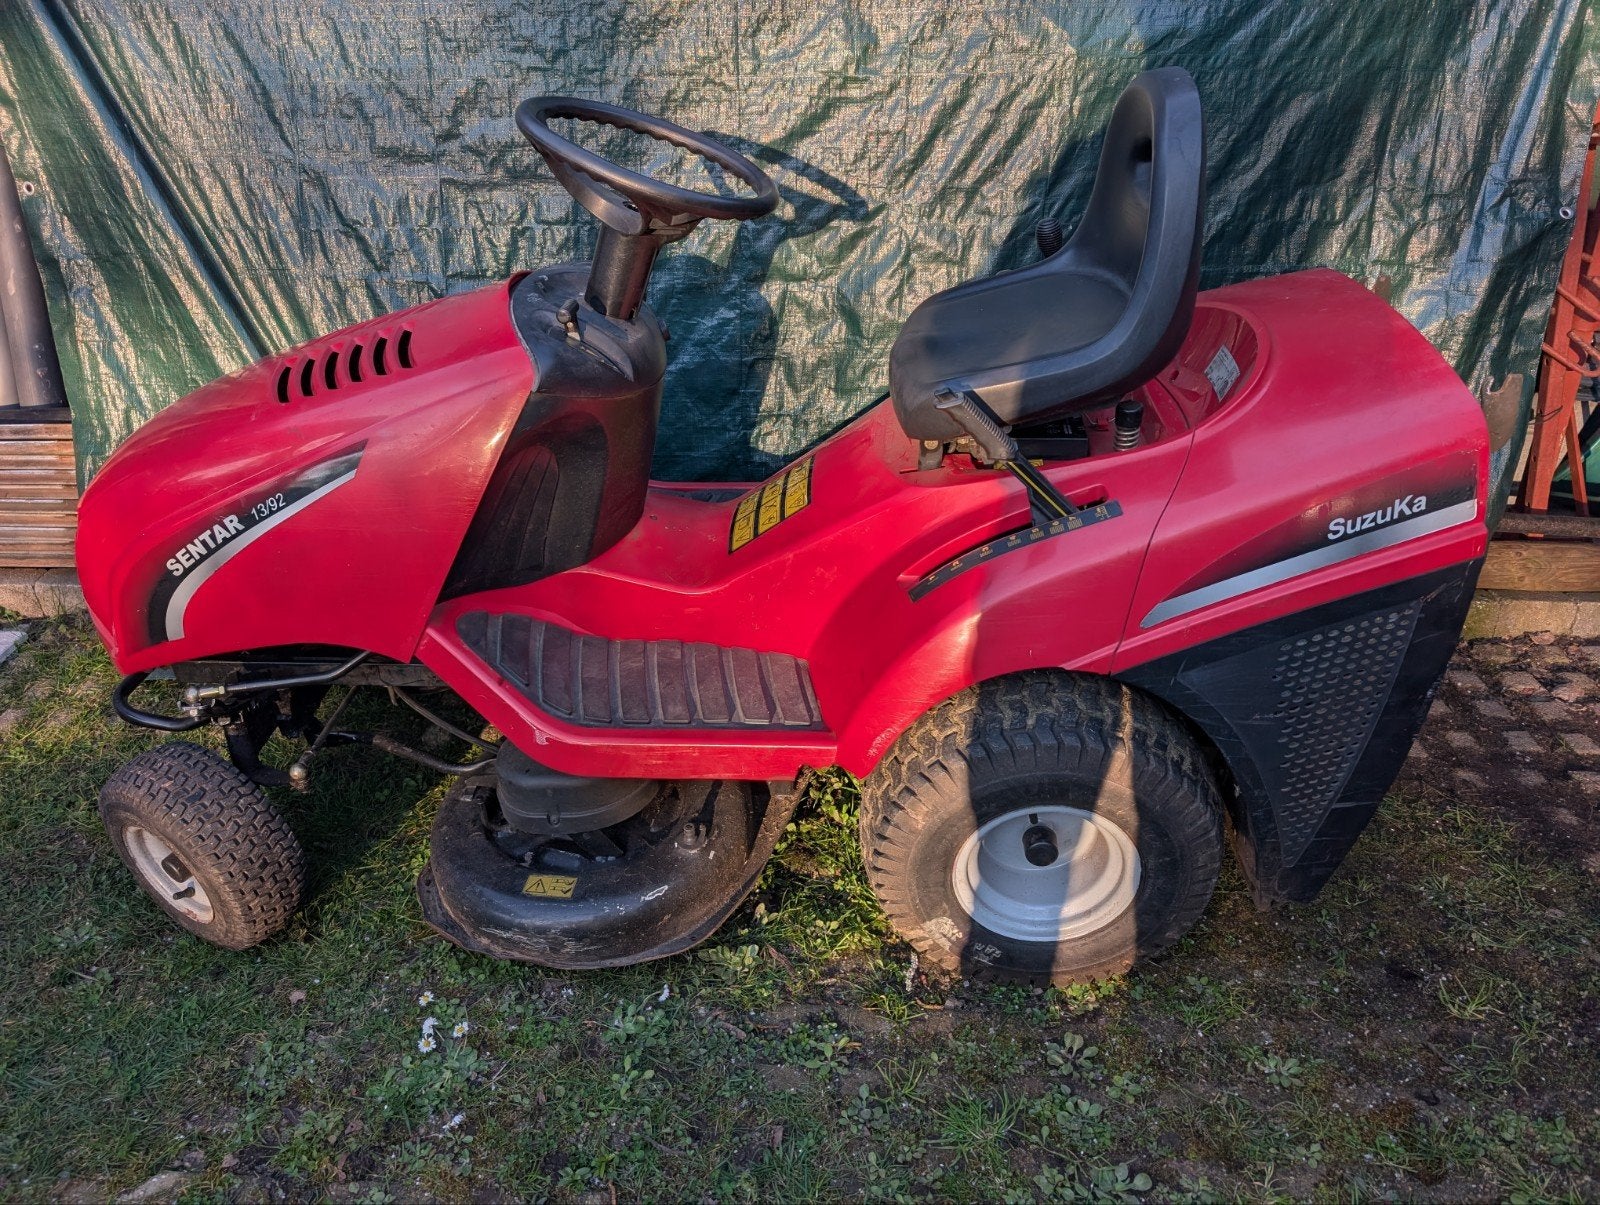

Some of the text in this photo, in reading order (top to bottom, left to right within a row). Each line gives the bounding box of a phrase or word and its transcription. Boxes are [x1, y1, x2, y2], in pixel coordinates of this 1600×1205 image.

[166, 493, 286, 577] SENTAR 13/92
[1327, 494, 1427, 540] SuzuKa
